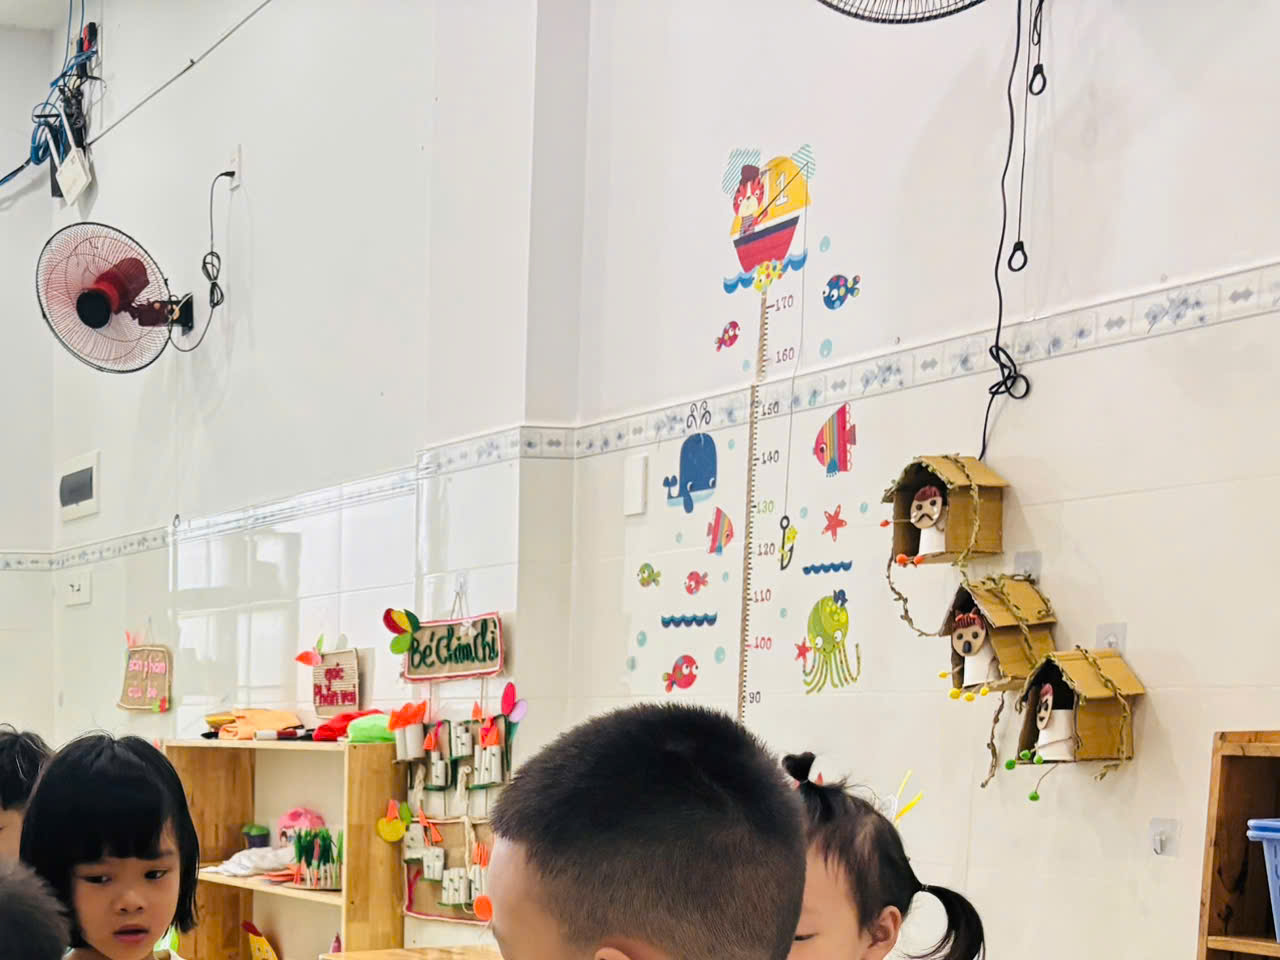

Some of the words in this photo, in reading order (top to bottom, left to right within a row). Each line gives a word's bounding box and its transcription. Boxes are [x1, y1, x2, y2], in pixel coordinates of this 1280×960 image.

[775, 294, 794, 312] 170
[776, 347, 795, 364] 160
[761, 401, 779, 417] 150
[761, 450, 779, 465] 140
[756, 500, 775, 514] 130
[757, 542, 776, 556] 120
[754, 588, 772, 603] 110
[410, 632, 435, 669] Bé
[754, 636, 772, 650] 100
[749, 690, 761, 704] 90
